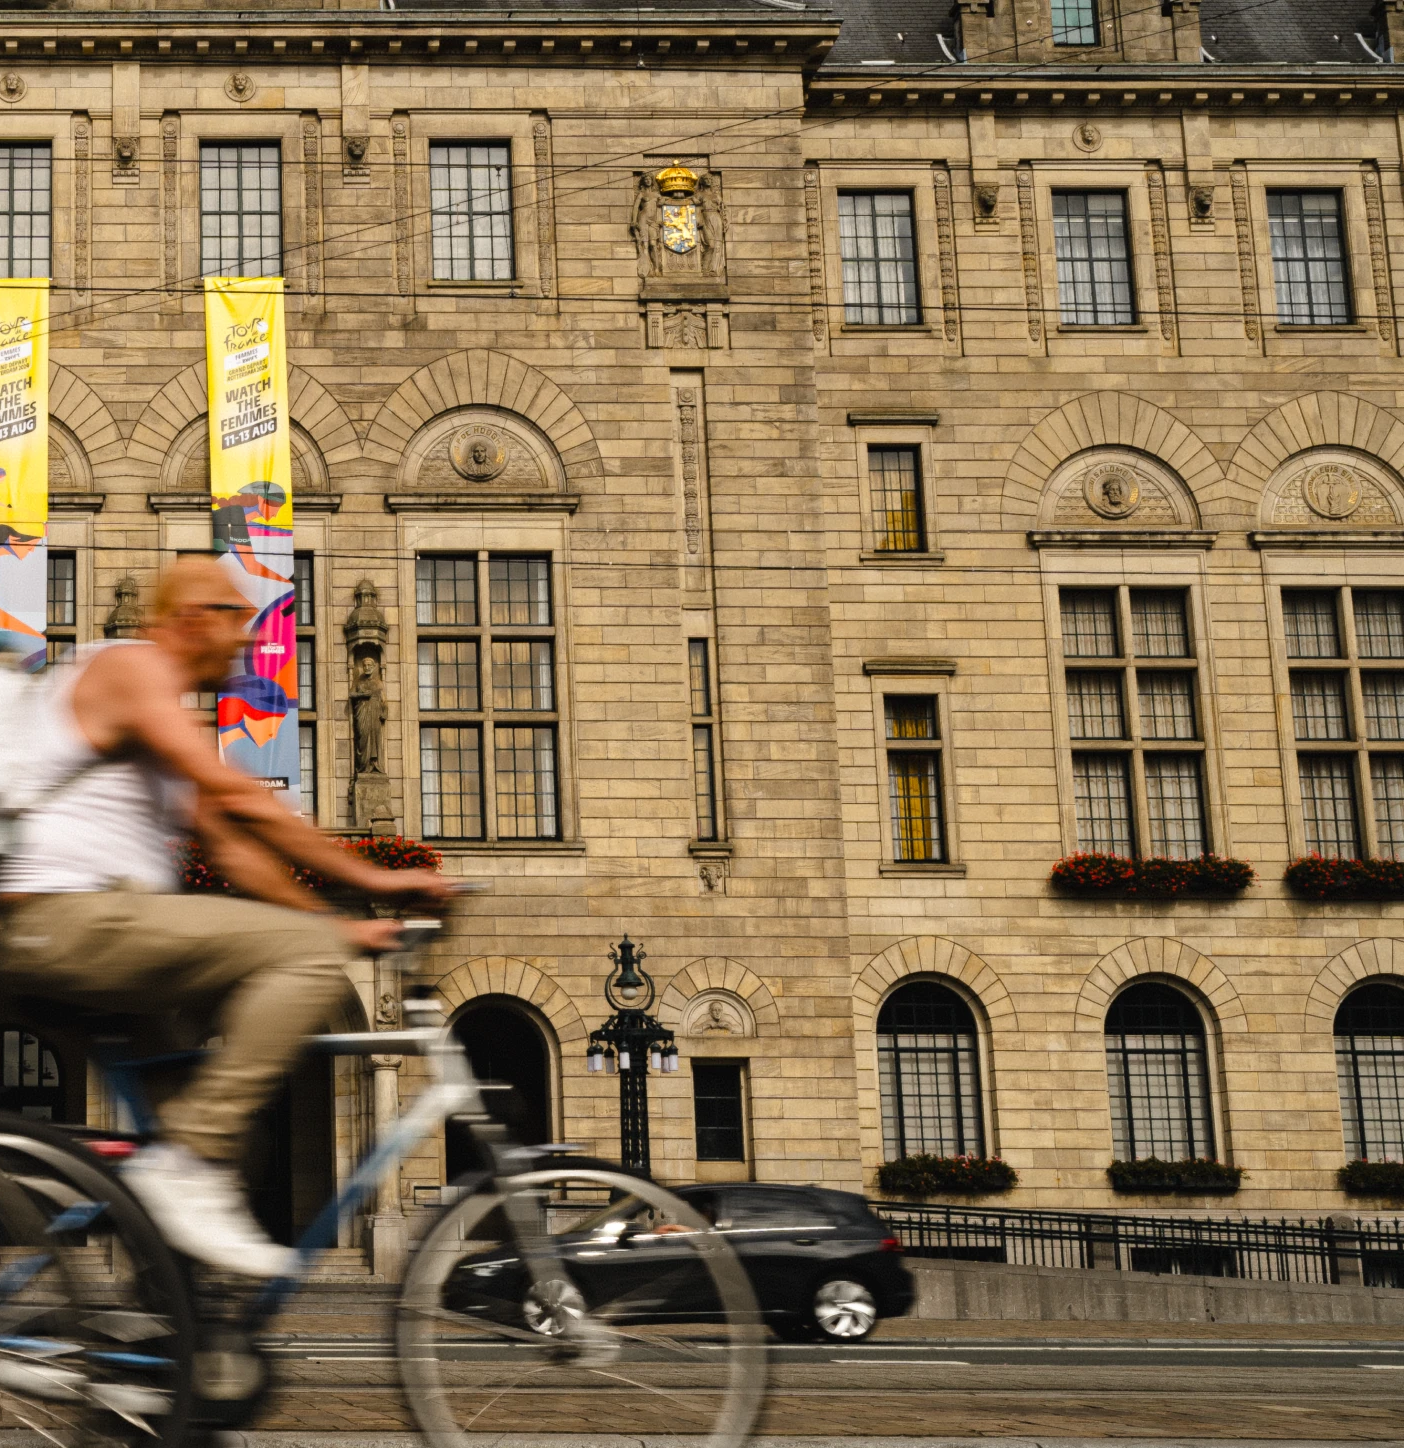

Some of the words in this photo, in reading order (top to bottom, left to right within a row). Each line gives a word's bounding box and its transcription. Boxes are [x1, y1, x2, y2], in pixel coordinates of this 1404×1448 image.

[226, 376, 271, 403] WATCH
[236, 394, 260, 413] THE
[11, 420, 34, 436] AUG
[220, 402, 277, 432] FEMMES
[224, 429, 250, 446] 11-13
[252, 420, 274, 438] AUG
